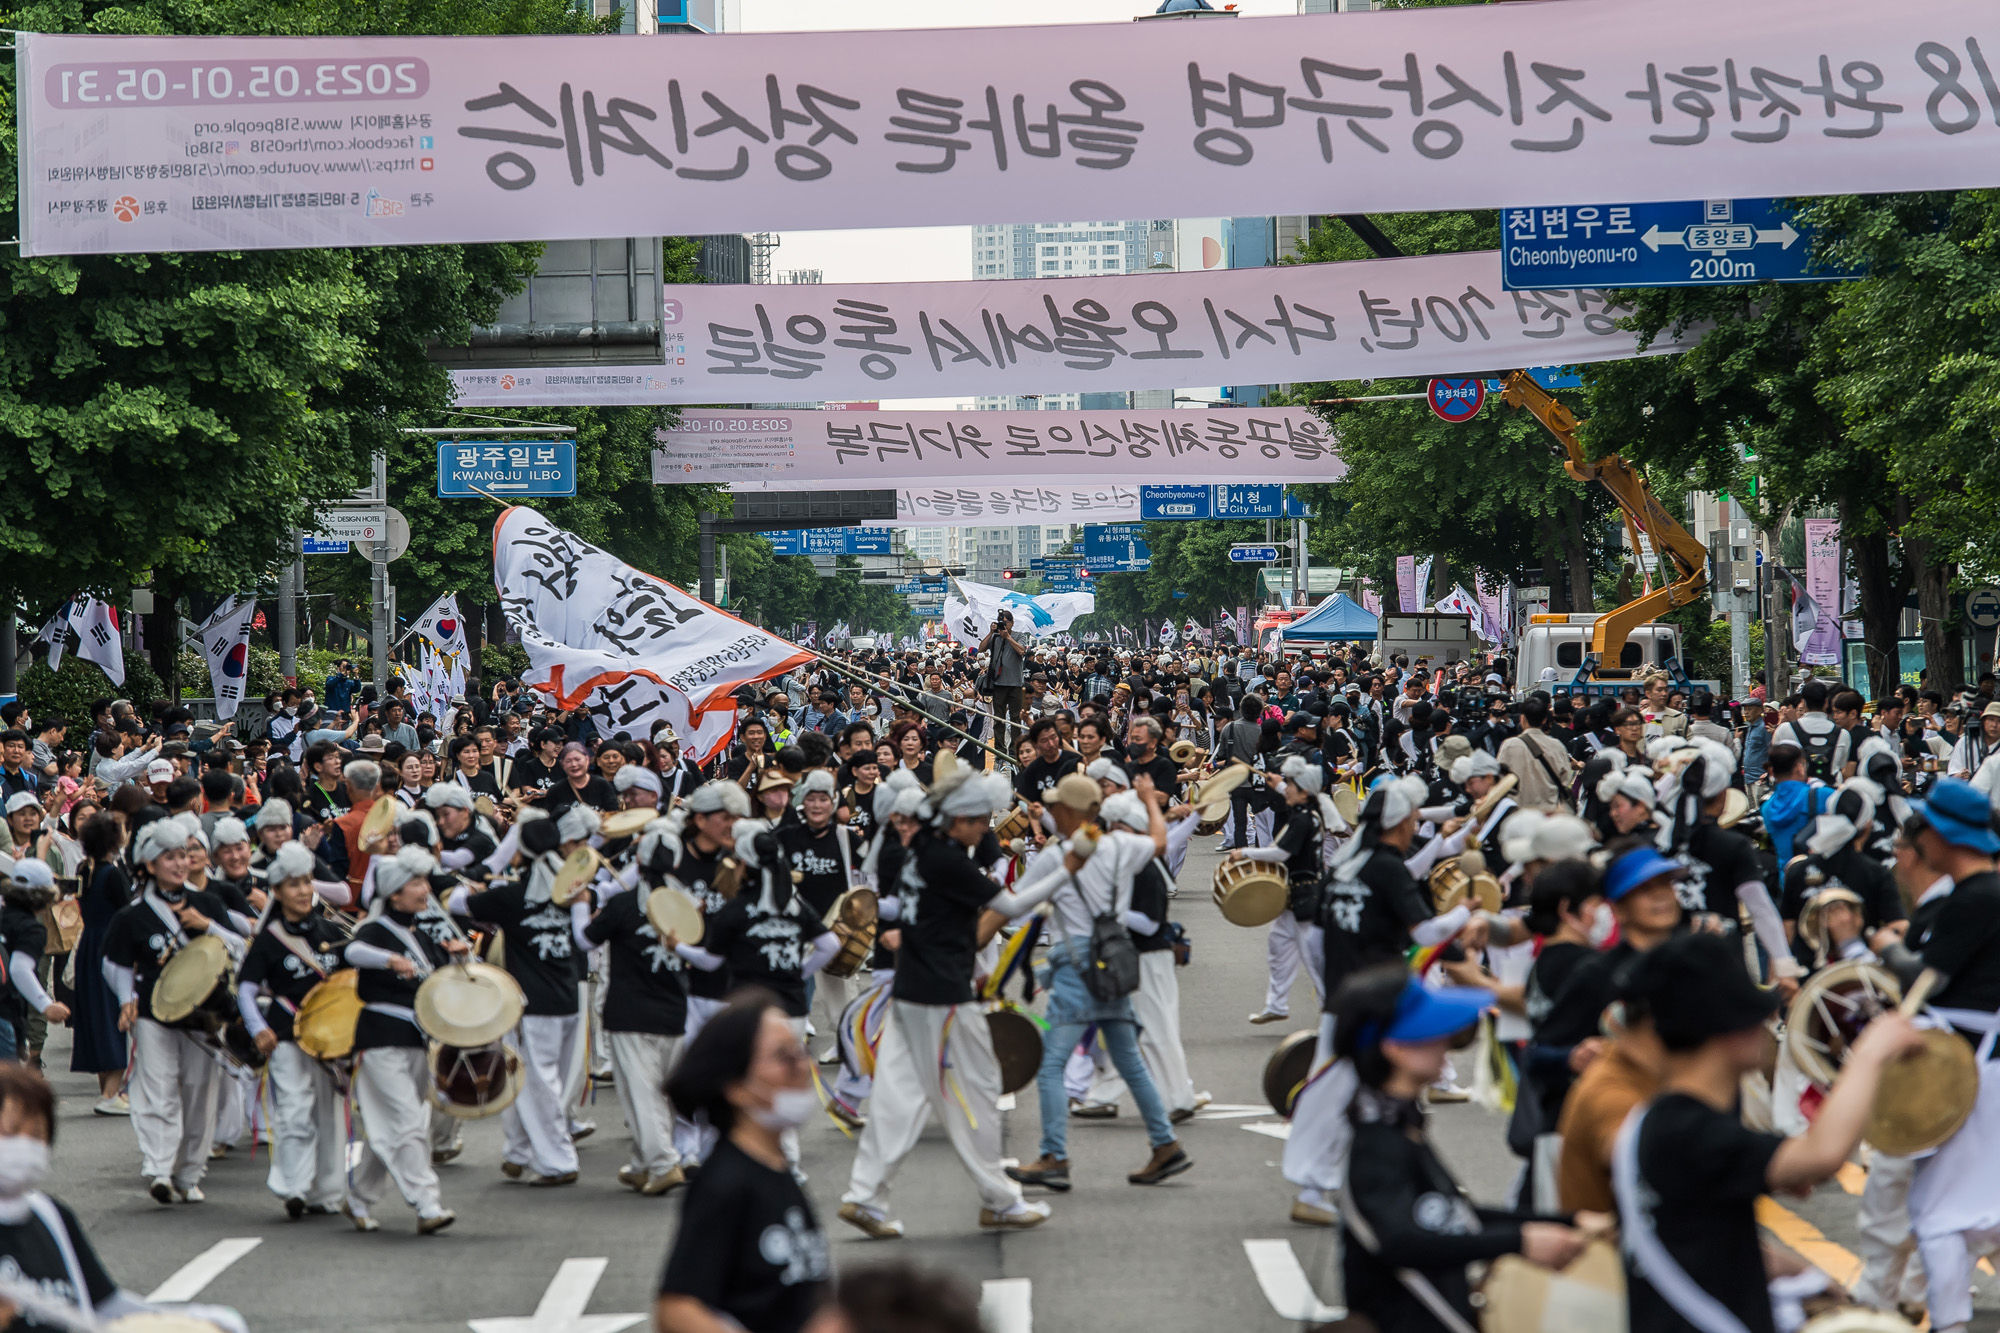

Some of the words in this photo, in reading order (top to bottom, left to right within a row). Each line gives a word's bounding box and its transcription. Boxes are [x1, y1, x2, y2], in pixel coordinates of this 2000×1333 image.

[1508, 206, 1637, 241] 천변우로
[1693, 229, 1748, 247] 중앙로
[1509, 246, 1638, 270] Cheonbyeonu-ro
[1690, 258, 1756, 279] 200m
[1436, 388, 1476, 399] 주정차금지
[456, 447, 558, 468] 광주일보
[452, 470, 522, 481] KWANGJU
[529, 470, 561, 481] ILBO
[1145, 490, 1206, 500] Cheonbyeonu-ro
[1230, 491, 1260, 504] 시청
[1229, 505, 1249, 514] City
[1254, 504, 1272, 513] Hall
